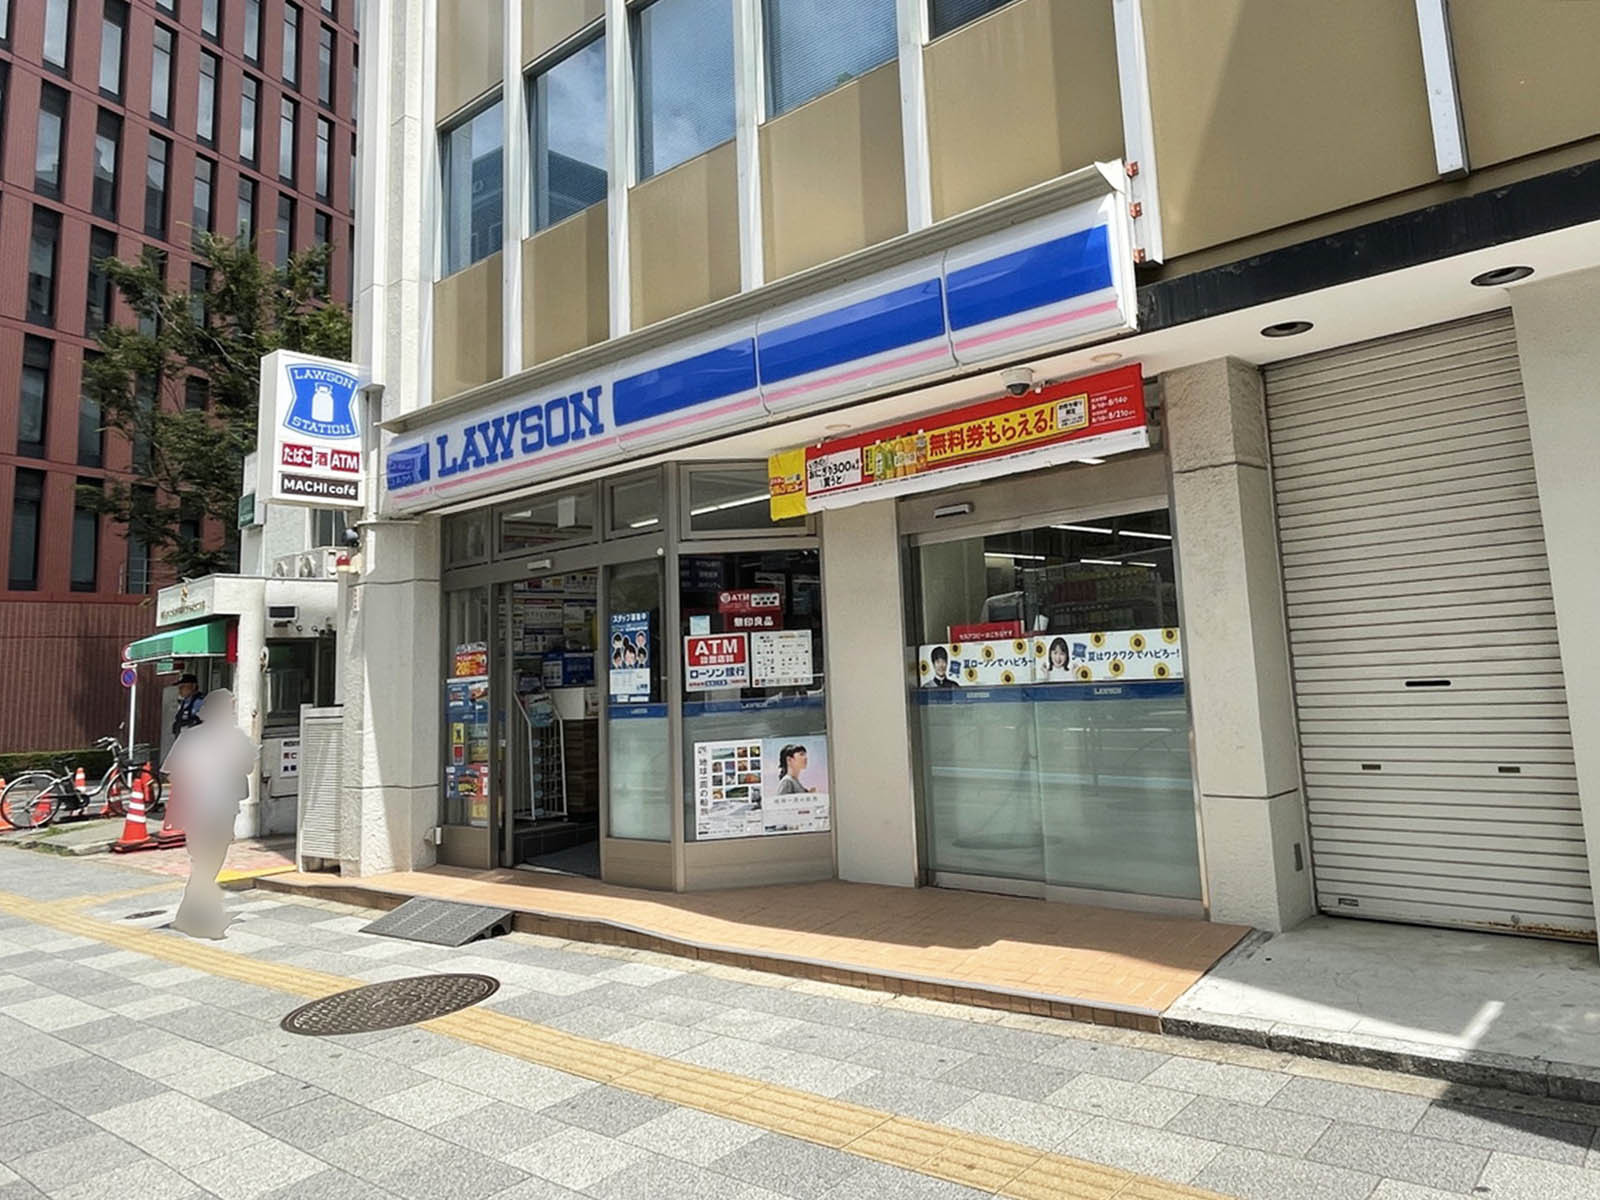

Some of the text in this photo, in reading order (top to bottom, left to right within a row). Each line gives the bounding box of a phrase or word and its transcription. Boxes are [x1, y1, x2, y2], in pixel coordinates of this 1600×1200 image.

[293, 368, 355, 389] LAWSON
[291, 415, 351, 434] STATION
[437, 385, 604, 477] LAWSON
[929, 406, 1055, 457] 無料券もらえる!
[283, 446, 312, 465] たばこ
[332, 453, 358, 470] ATM
[283, 478, 357, 496] MACHI café
[695, 638, 738, 656] ATM
[690, 666, 745, 679] ローソン銀行
